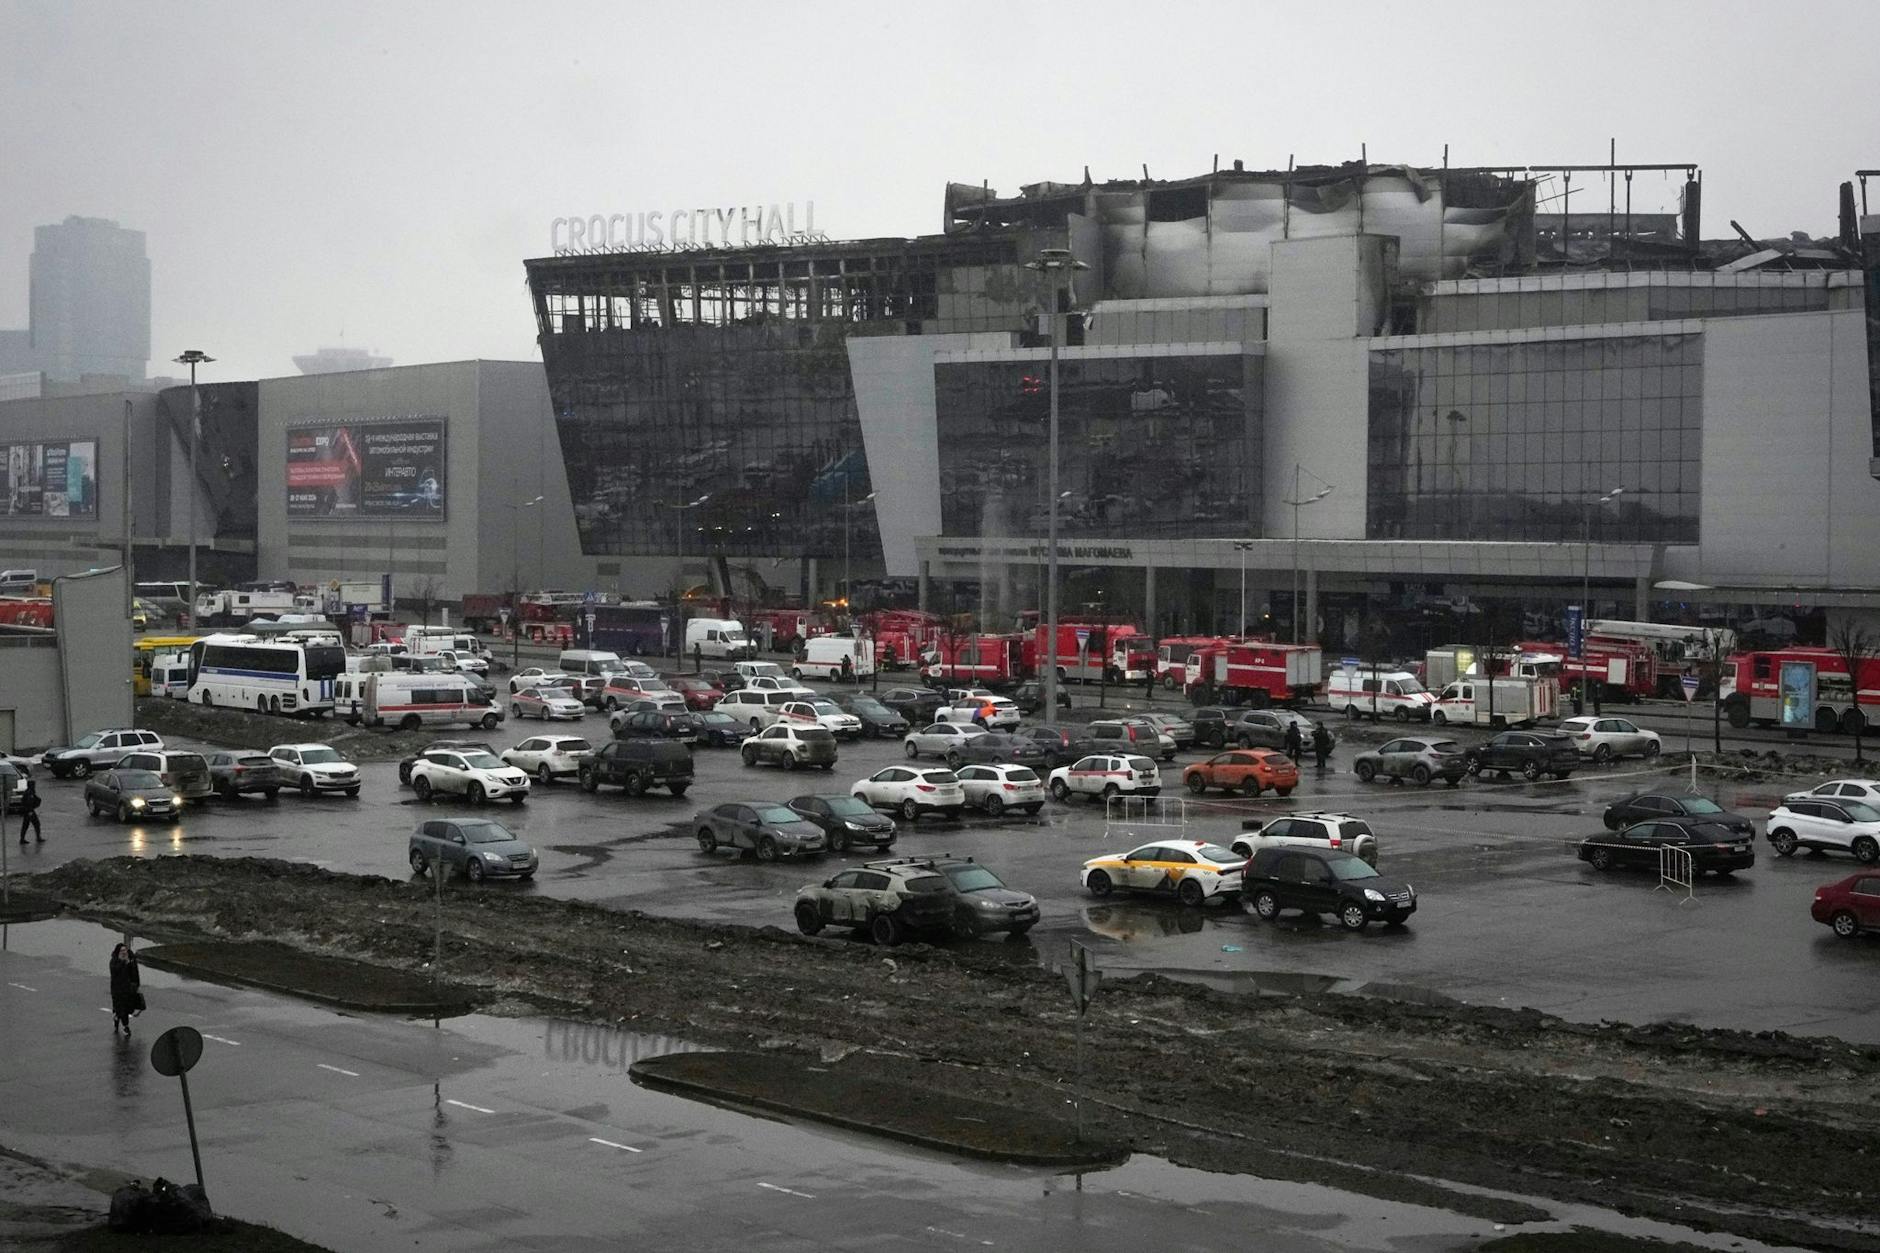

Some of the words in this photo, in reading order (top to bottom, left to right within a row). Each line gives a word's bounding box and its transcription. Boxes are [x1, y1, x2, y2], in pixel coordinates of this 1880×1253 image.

[551, 211, 664, 250] CROCUS
[670, 207, 735, 244] CITY
[741, 201, 824, 240] HALL
